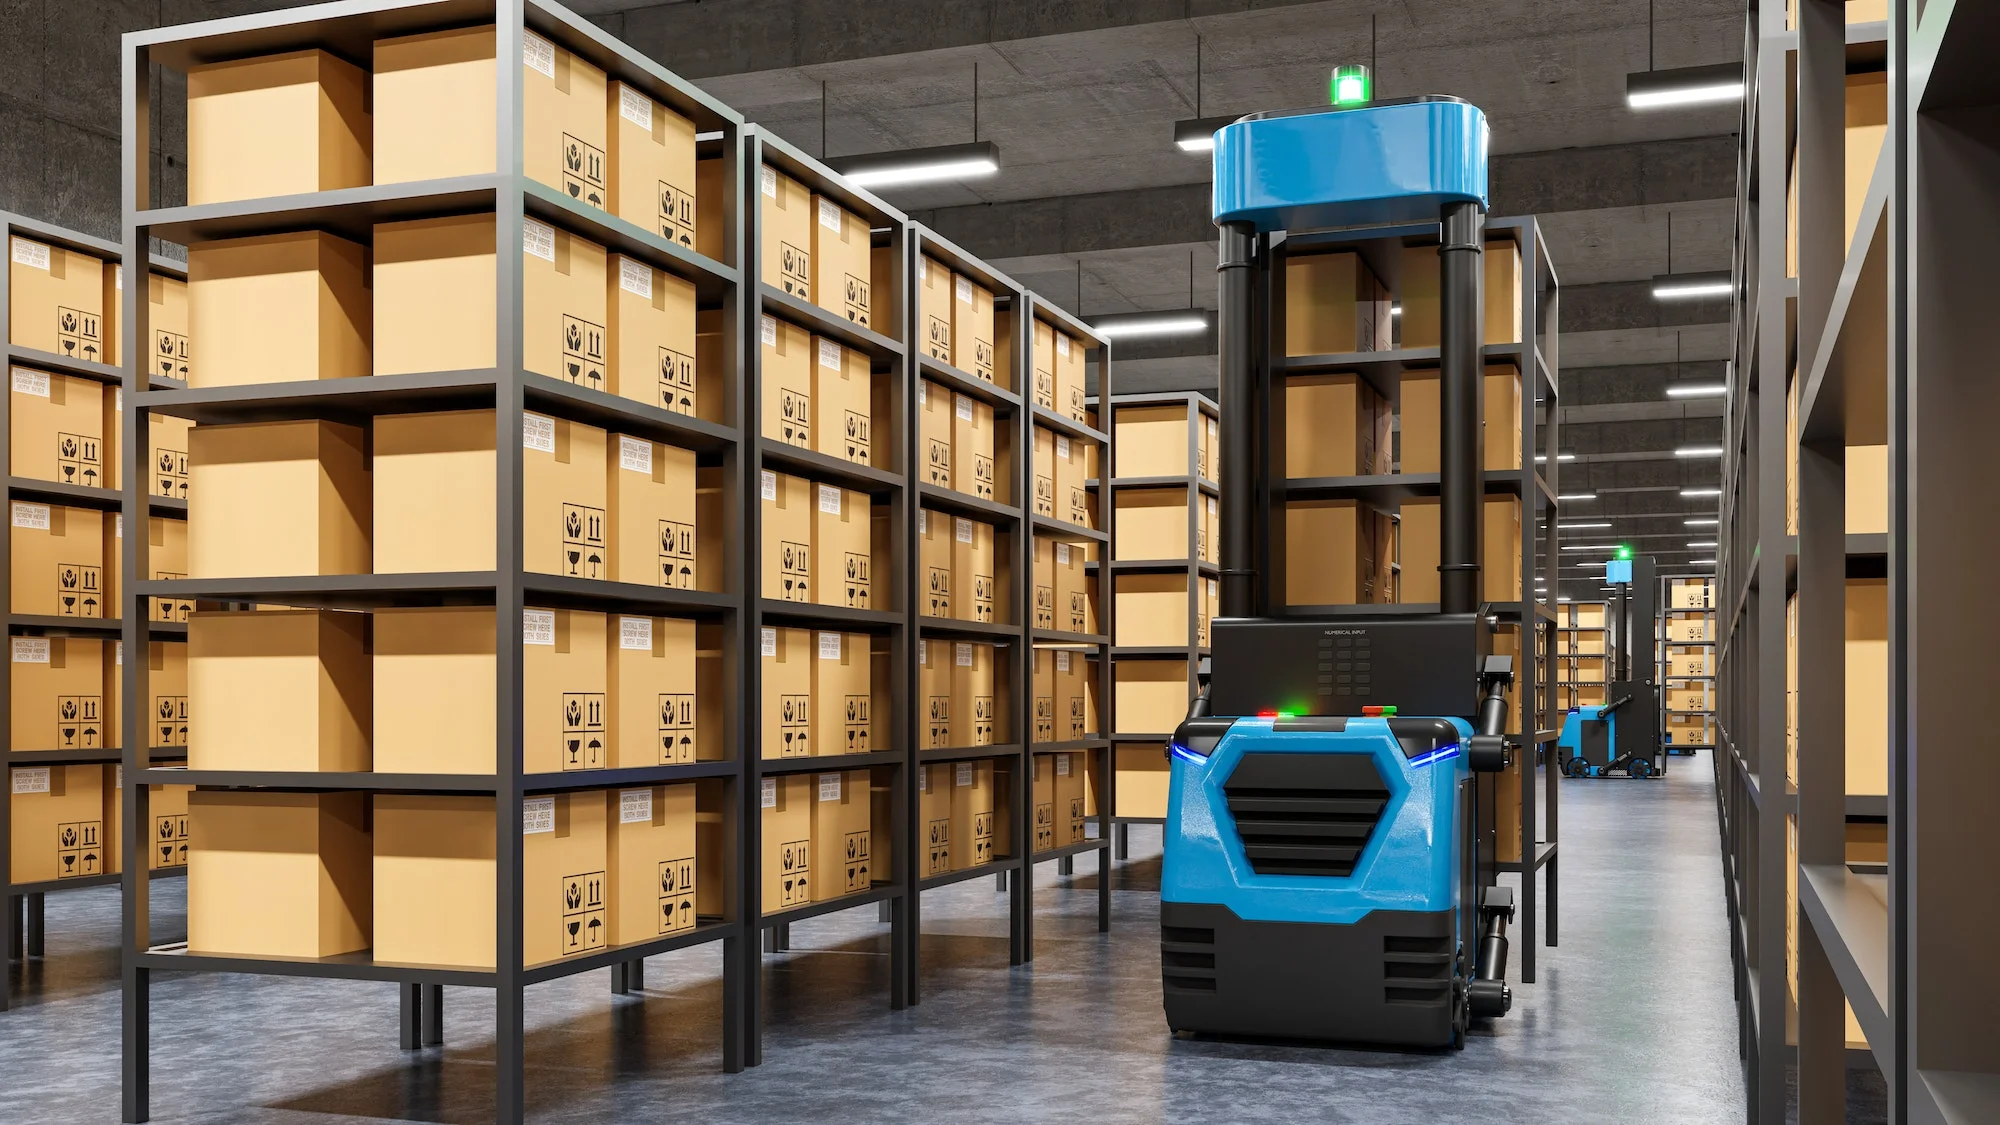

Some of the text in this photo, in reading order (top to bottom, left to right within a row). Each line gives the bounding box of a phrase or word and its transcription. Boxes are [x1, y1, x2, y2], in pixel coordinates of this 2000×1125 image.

[524, 418, 537, 428] STALL
[524, 426, 536, 436] CREW
[524, 435, 534, 444] OTH
[524, 623, 550, 632] CREW HERE
[524, 804, 537, 812] STALL
[524, 812, 550, 821] CREW HERE
[536, 820, 549, 828] SIDES
